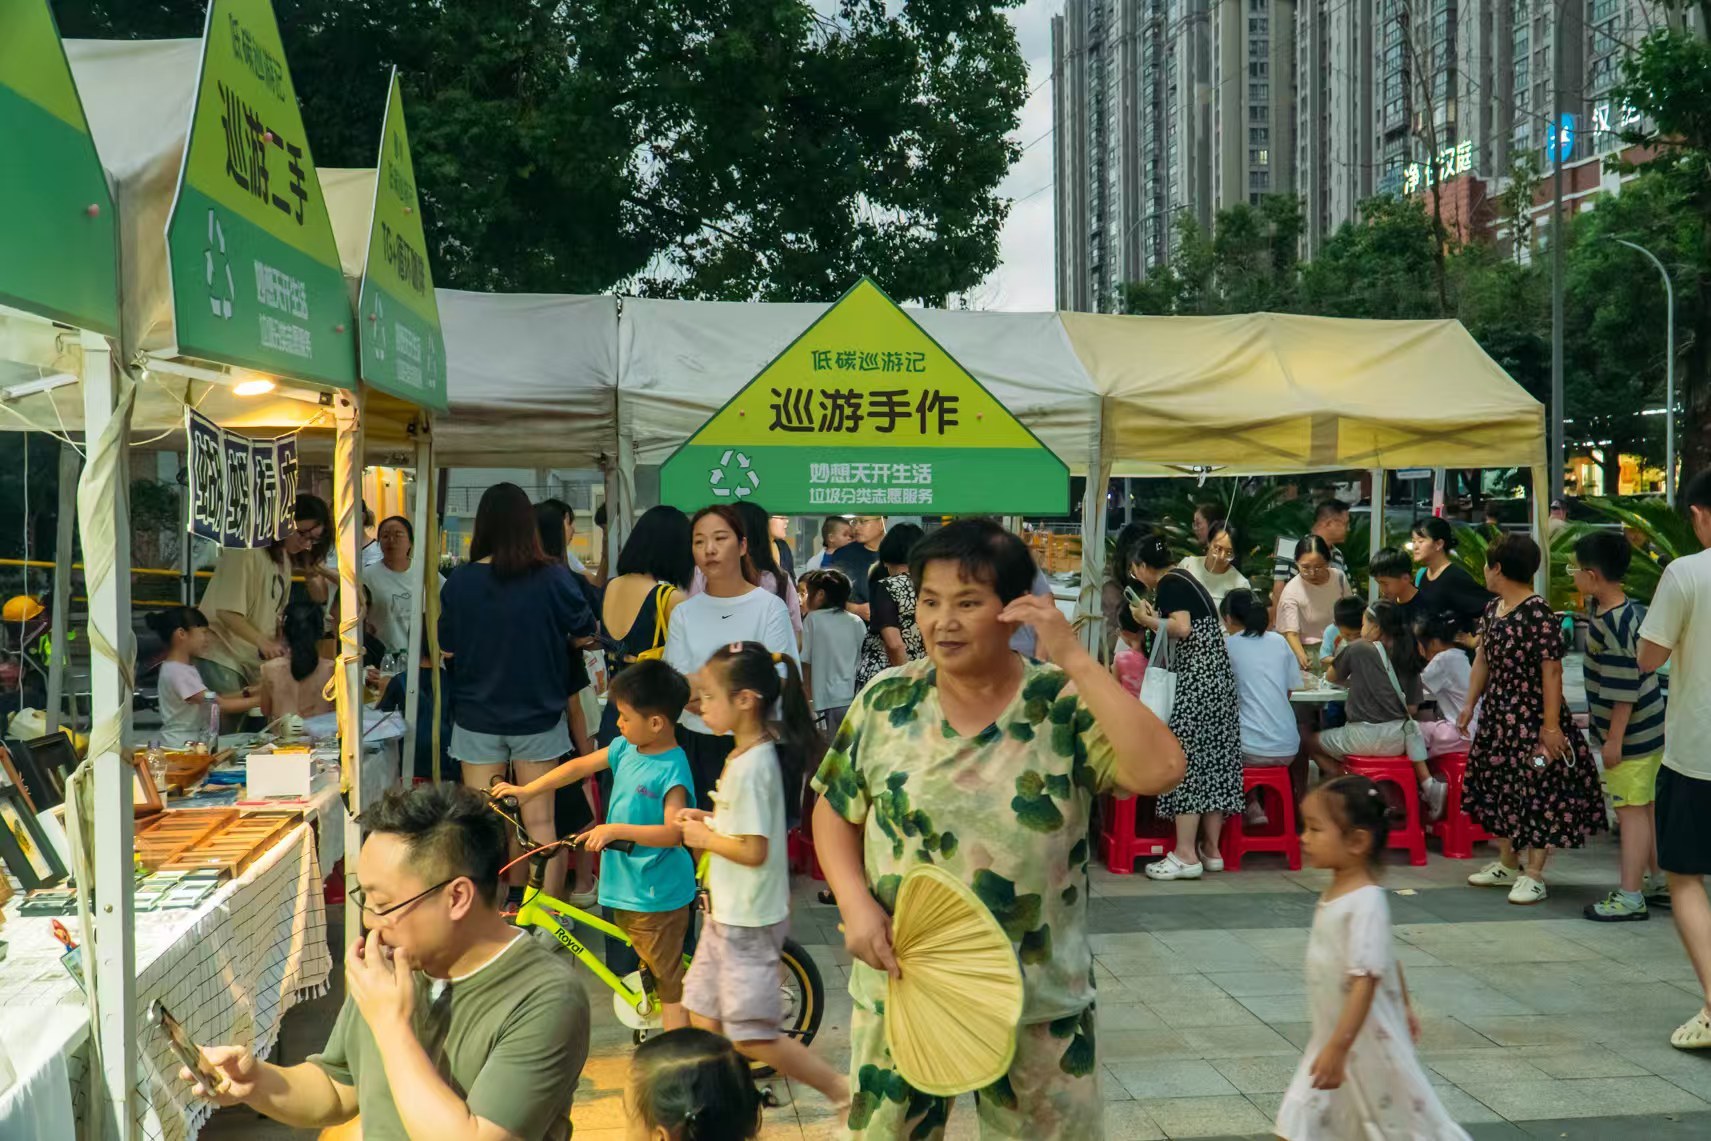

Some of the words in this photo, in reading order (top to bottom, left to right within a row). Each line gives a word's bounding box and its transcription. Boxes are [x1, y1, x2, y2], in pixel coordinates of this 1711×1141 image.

[217, 80, 308, 226] 巡游二手
[811, 350, 926, 373] 低碳巡游记
[769, 387, 960, 435] 巡游手作
[809, 462, 932, 484] 妙想天开生活
[809, 487, 933, 504] 垃圾分类志愿服务
[554, 927, 585, 954] Royal
